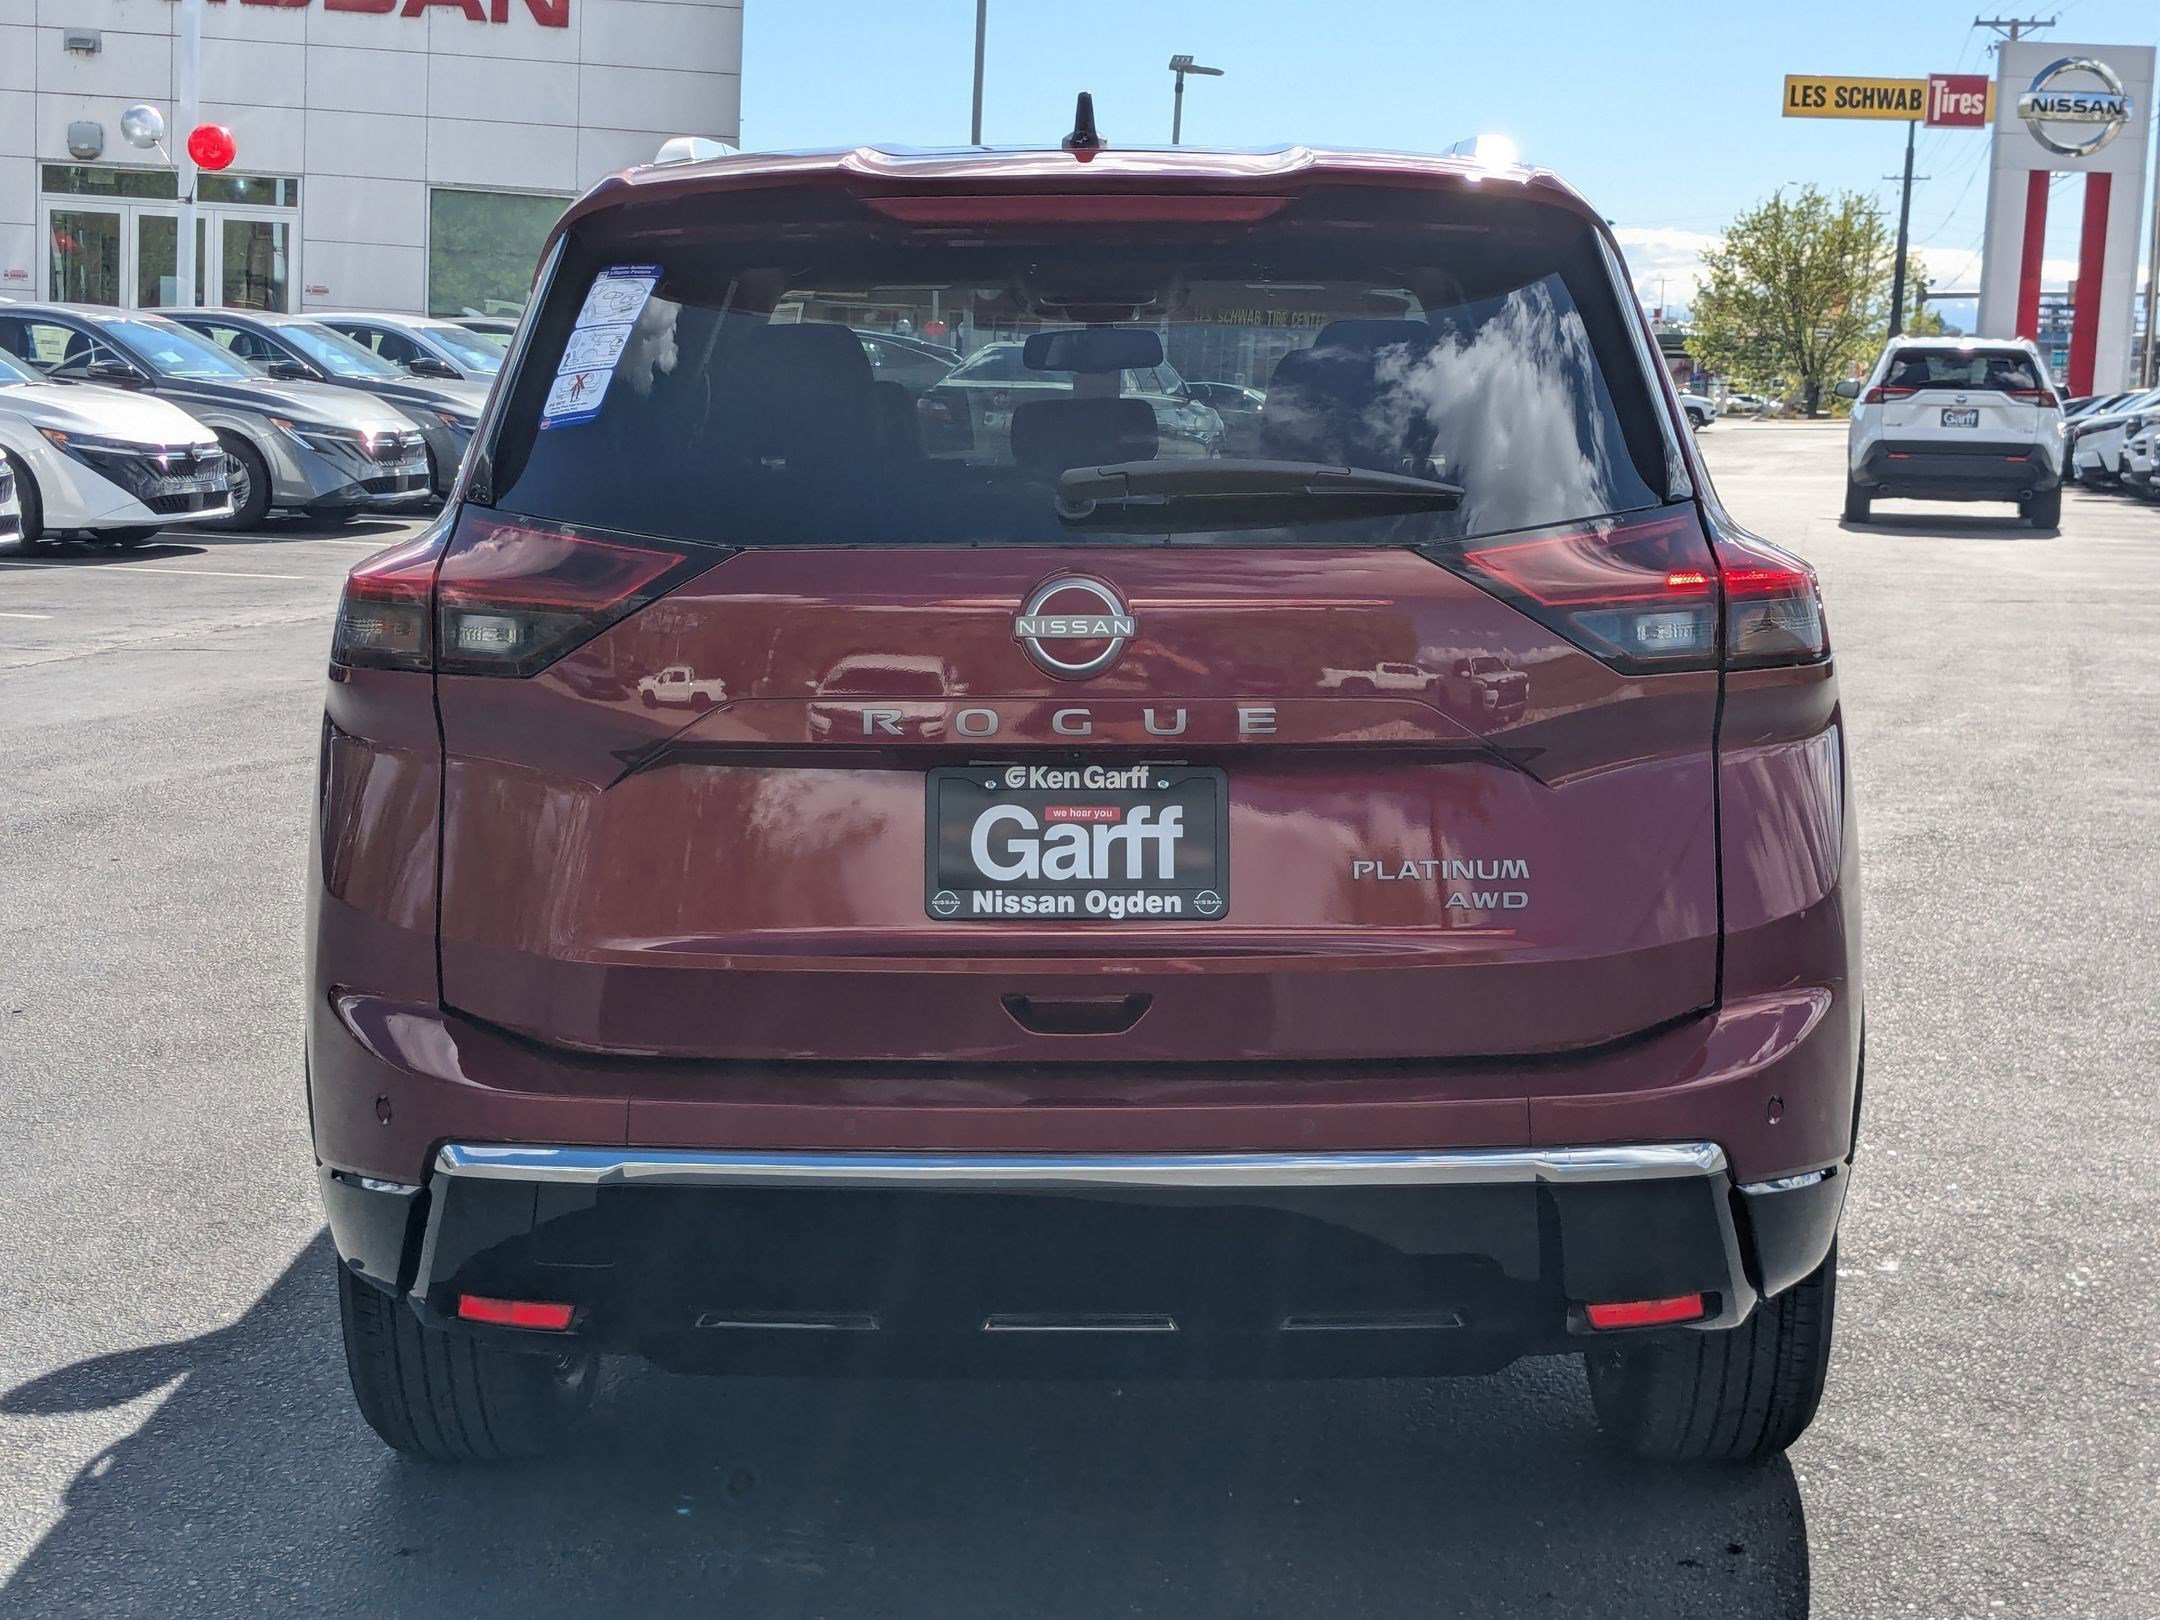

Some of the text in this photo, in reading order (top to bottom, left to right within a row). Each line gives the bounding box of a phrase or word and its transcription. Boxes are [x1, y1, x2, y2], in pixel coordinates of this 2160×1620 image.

[1789, 80, 1985, 121] LES SCHWAB Tires
[2030, 98, 2122, 115] NISSAN
[1216, 309, 1261, 325] SCHWAB
[1266, 310, 1288, 328] TIRE
[1019, 620, 1131, 634] NISSAN
[862, 708, 1278, 737] ROGUE
[1030, 766, 1150, 789] Ken Garff
[1053, 808, 1113, 820] we hear you
[971, 804, 1184, 881] Garff
[1353, 859, 1530, 880] PLATINUM
[972, 890, 1182, 919] Nissan Ogden
[1444, 891, 1529, 909] AWD
